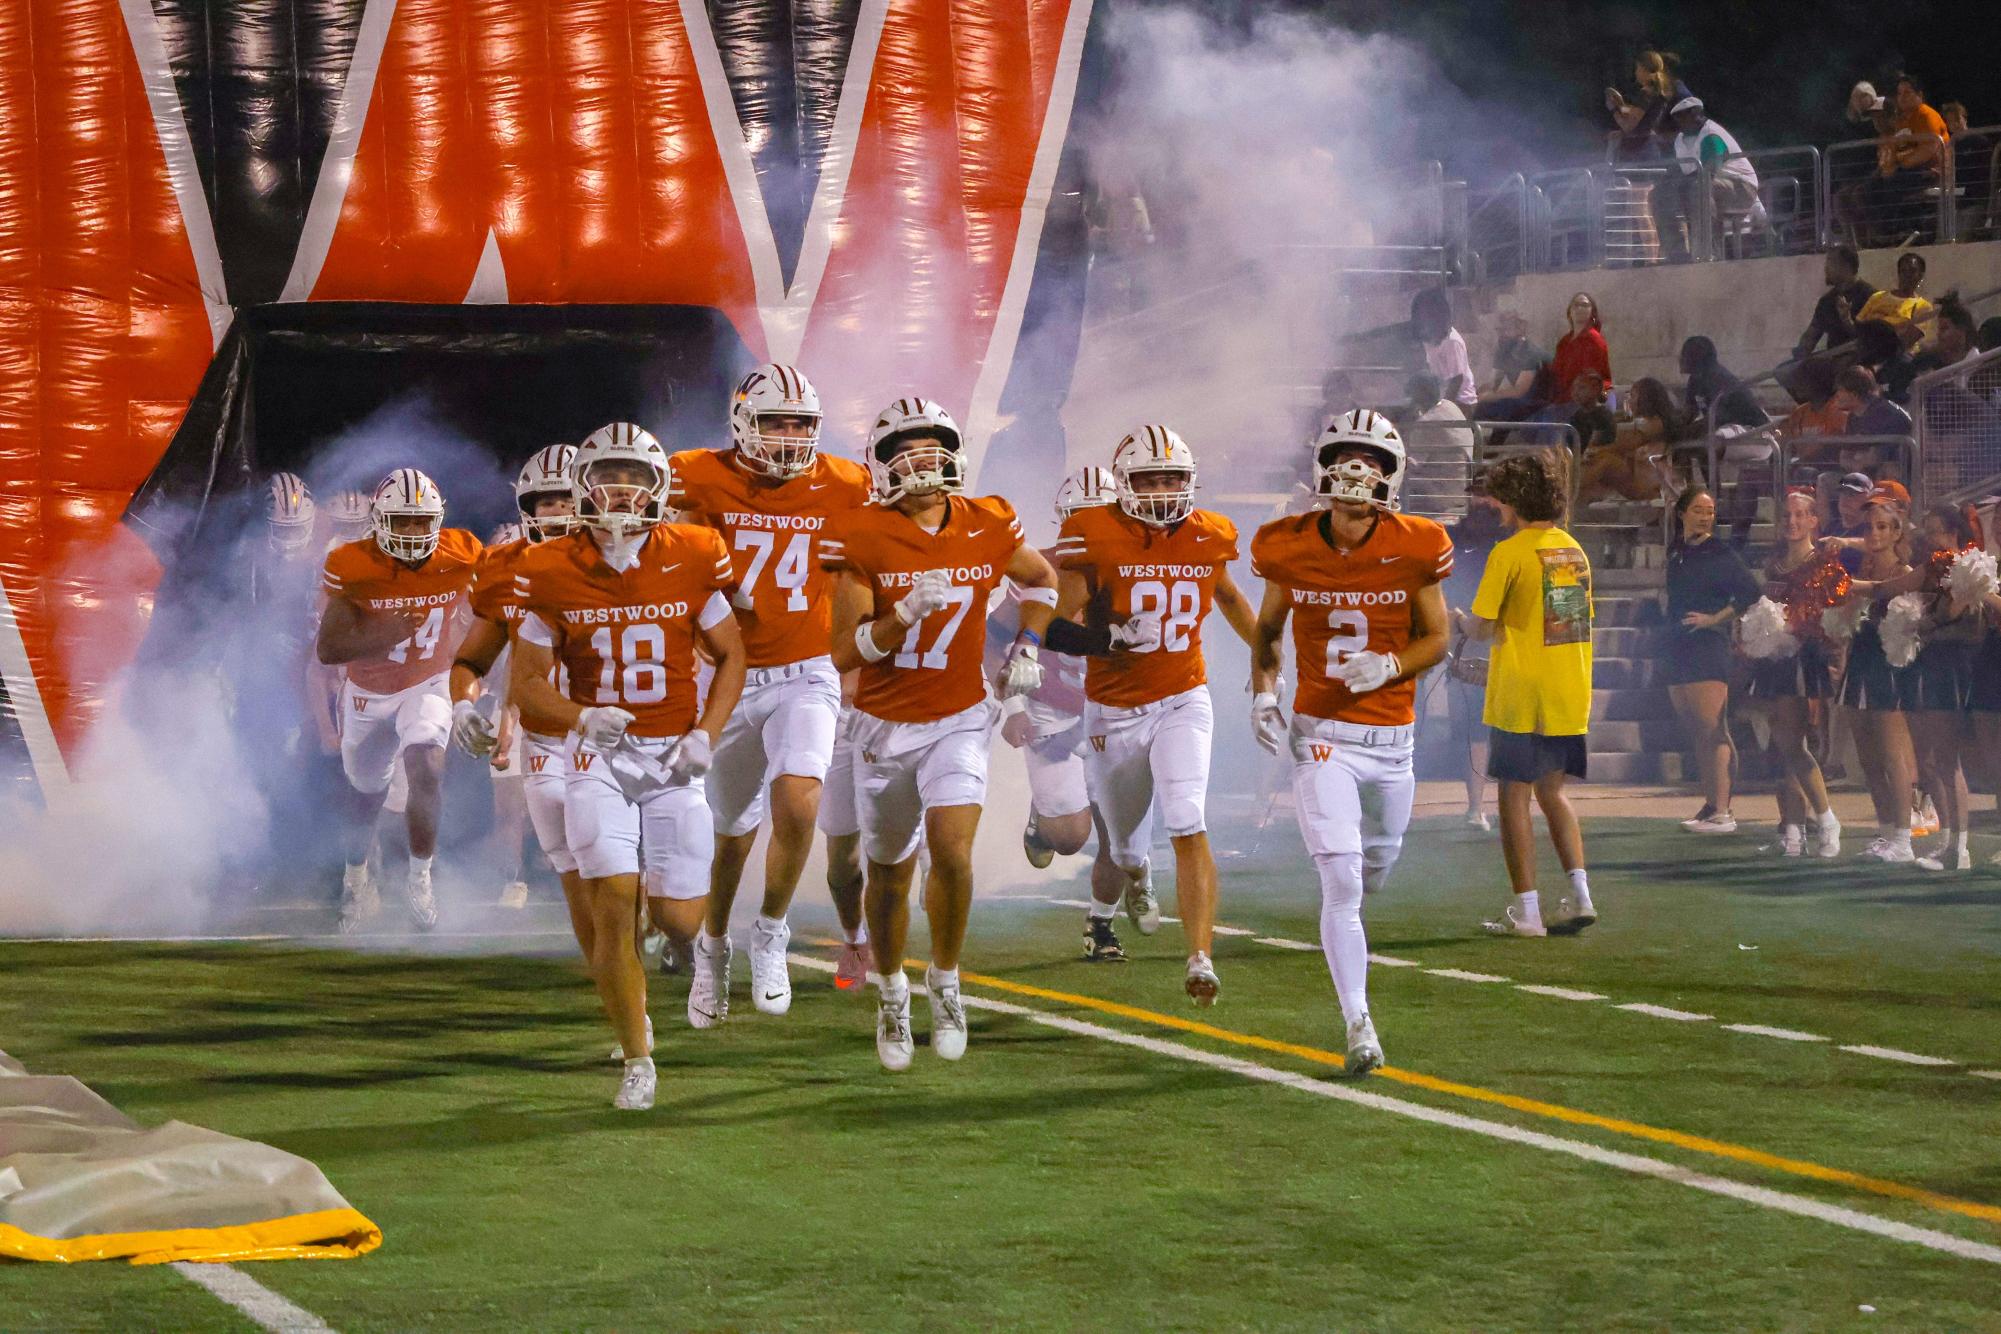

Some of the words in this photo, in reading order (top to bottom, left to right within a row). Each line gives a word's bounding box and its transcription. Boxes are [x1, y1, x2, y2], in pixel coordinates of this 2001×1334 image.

[732, 529, 811, 612] 74
[1118, 564, 1213, 578] WESTWOOD
[370, 590, 457, 609] WESTWOOD
[1291, 588, 1407, 606] WESTWOOD
[563, 601, 688, 624] WESTWOOD
[1325, 608, 1369, 681] 2
[590, 623, 667, 703] 18
[352, 695, 369, 712] W
[572, 751, 597, 772] W
[1309, 744, 1333, 762] W
[530, 754, 550, 773] W
